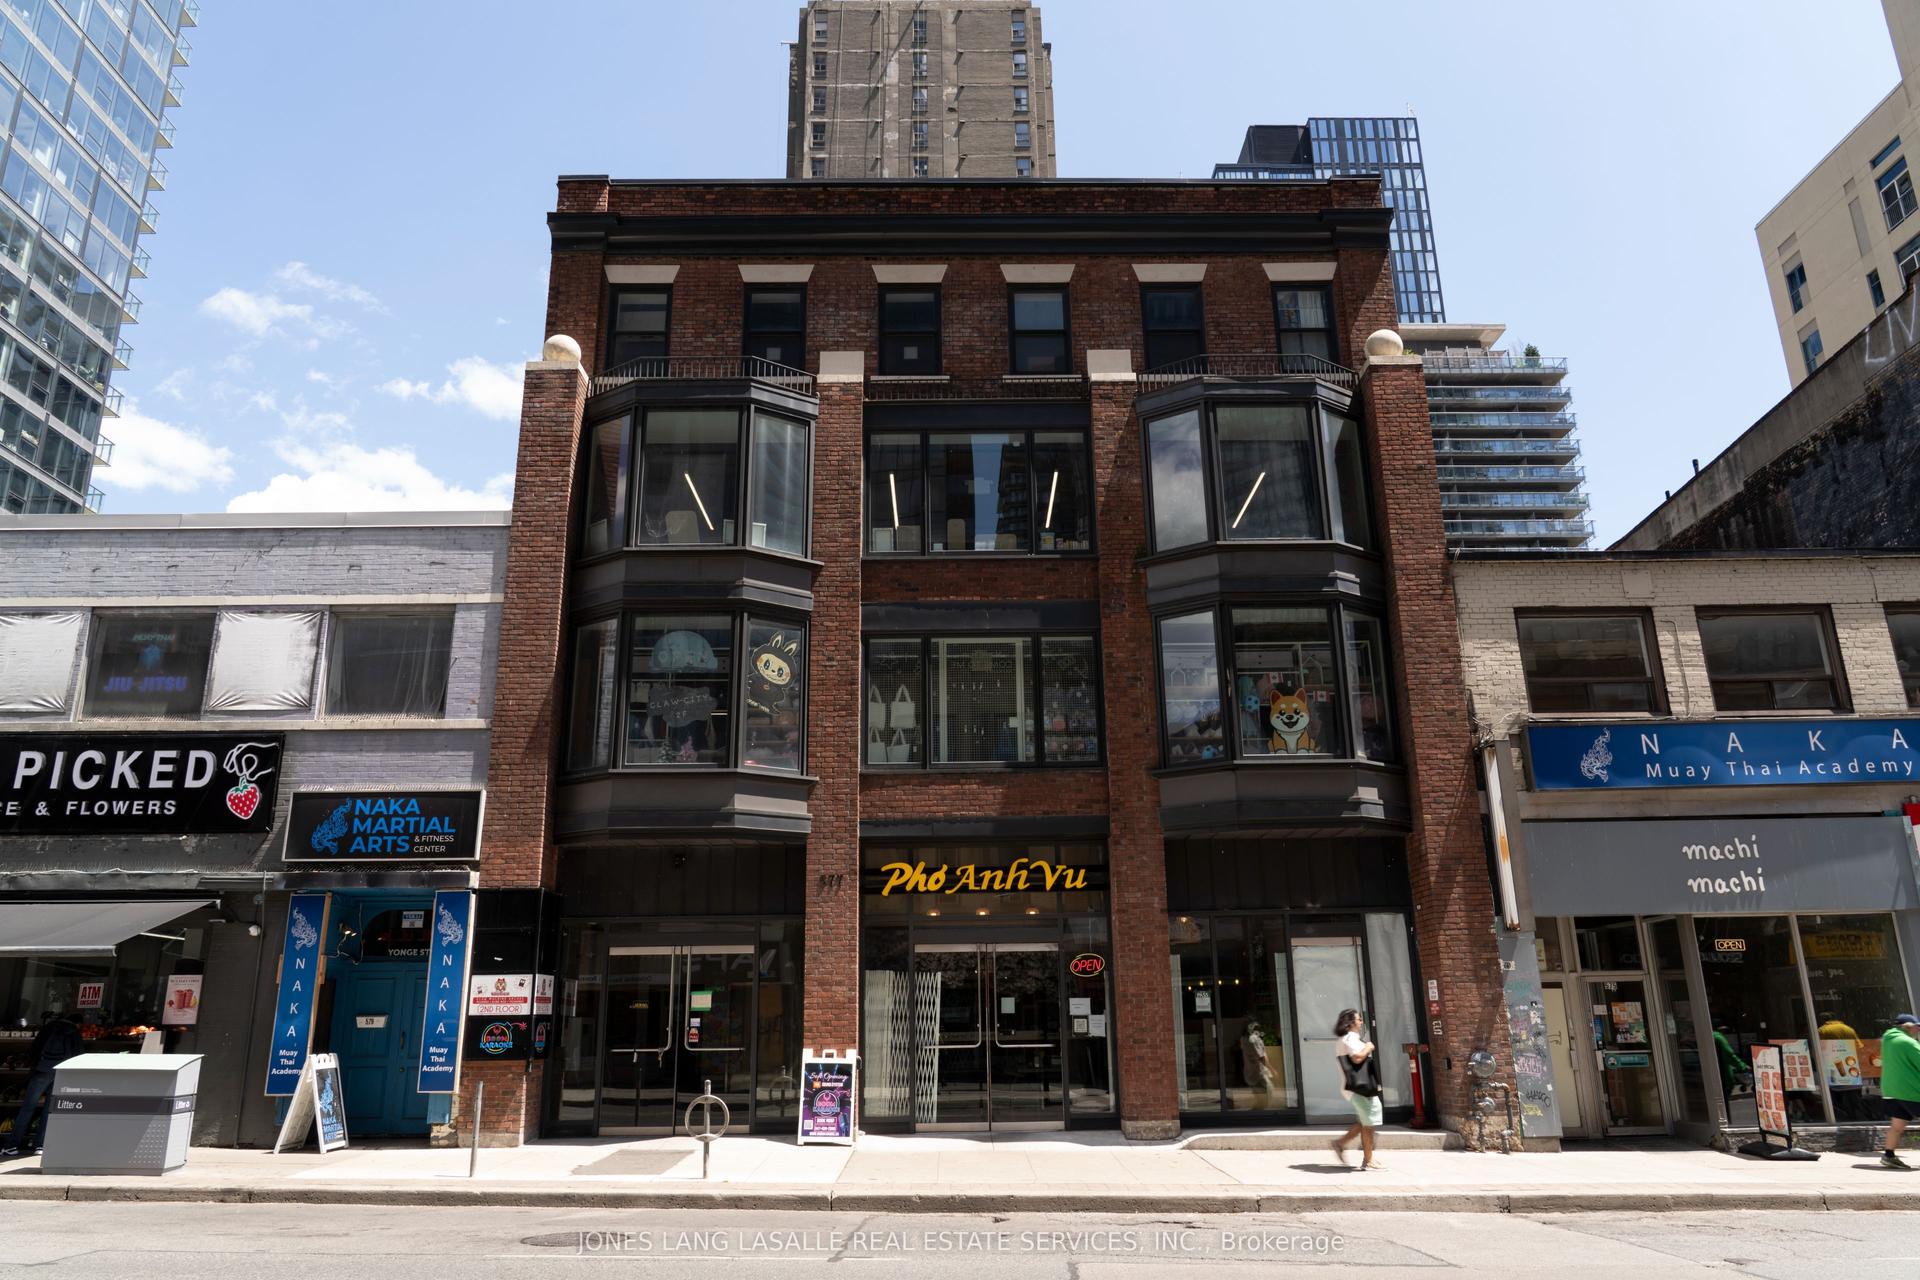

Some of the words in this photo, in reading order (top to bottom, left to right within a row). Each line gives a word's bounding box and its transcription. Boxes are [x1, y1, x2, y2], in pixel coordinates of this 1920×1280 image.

[103, 675, 132, 692] JIU
[138, 675, 187, 692] JITSU
[1640, 728, 1909, 755] NAKA
[13, 750, 217, 790] PICKED
[1646, 762, 1711, 781] Muay
[1726, 760, 1782, 776] Thai
[1799, 757, 1913, 776] Academy
[35, 801, 50, 816] &
[66, 800, 177, 816] FLOWERS
[354, 798, 421, 816] NAKA
[352, 816, 456, 835] MARTIAL
[350, 835, 410, 853] ARTS
[414, 835, 421, 843] &
[421, 834, 455, 843] FITNESS
[413, 845, 446, 853] CENTER
[1682, 834, 1759, 861] machi
[945, 857, 1030, 895] Anh
[1029, 860, 1088, 891] Vu
[1687, 867, 1765, 894] machi
[1717, 941, 1743, 950] OPEN
[388, 948, 418, 957] YONGE
[1071, 959, 1102, 972] OPEN
[81, 985, 101, 1000] ATM
[480, 1005, 493, 1013] 2ND
[495, 1005, 520, 1013] FLOOR
[429, 1046, 448, 1055] Muay
[480, 1041, 513, 1049] KARAOKE
[279, 1049, 298, 1058] Muay
[430, 1055, 445, 1063] Thai
[280, 1058, 295, 1066] Thai
[271, 1068, 302, 1077] Academy
[422, 1065, 453, 1073] Academy
[57, 1100, 76, 1109] Litter
